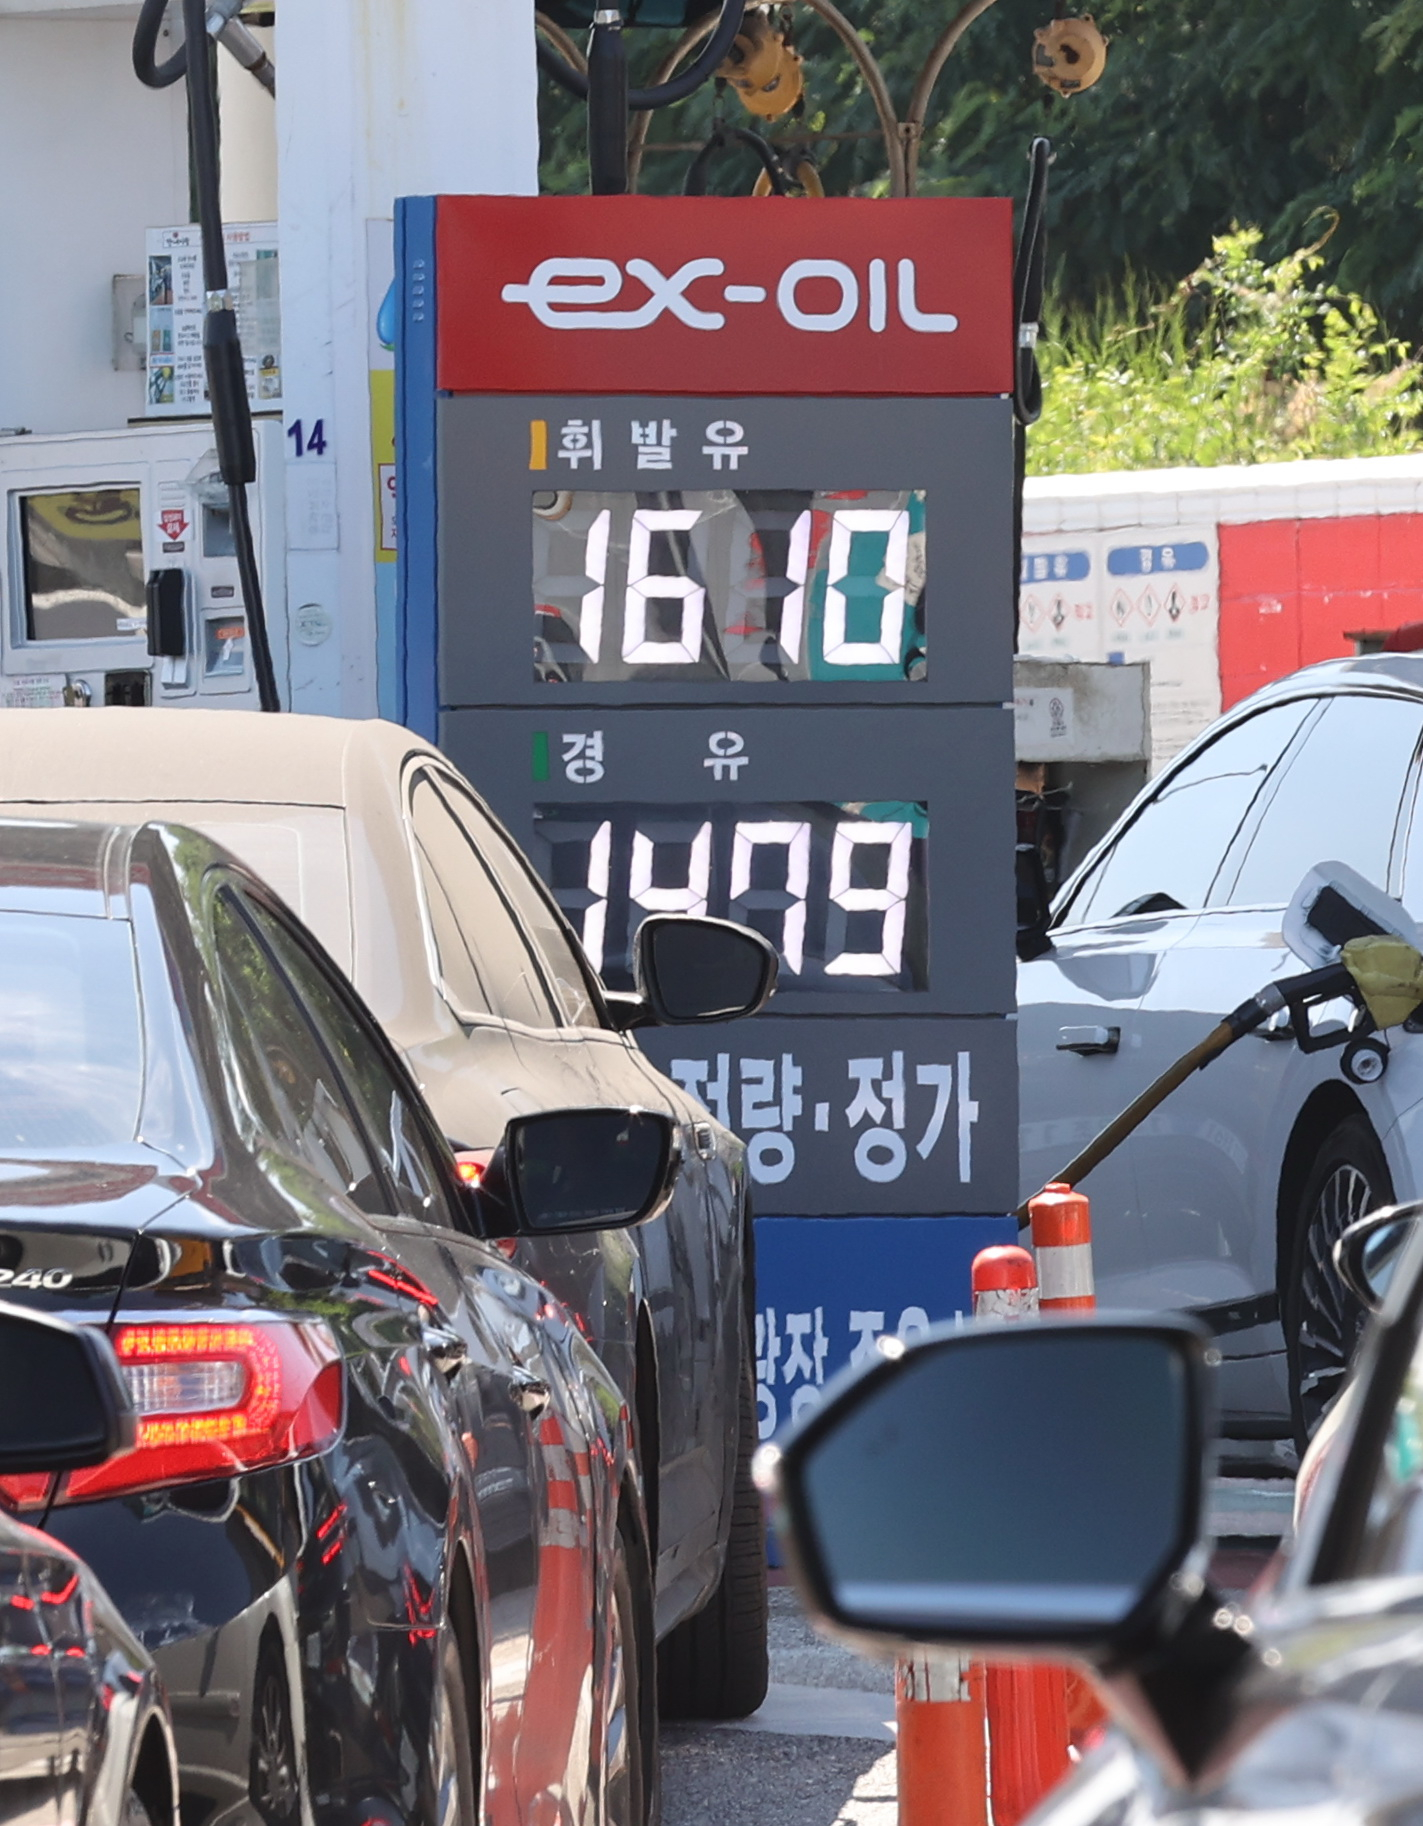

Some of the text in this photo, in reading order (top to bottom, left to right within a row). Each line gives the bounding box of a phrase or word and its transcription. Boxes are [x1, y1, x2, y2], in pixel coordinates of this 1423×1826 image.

[287, 418, 328, 458] 14
[579, 509, 911, 667] 1610
[583, 820, 914, 977] 1479
